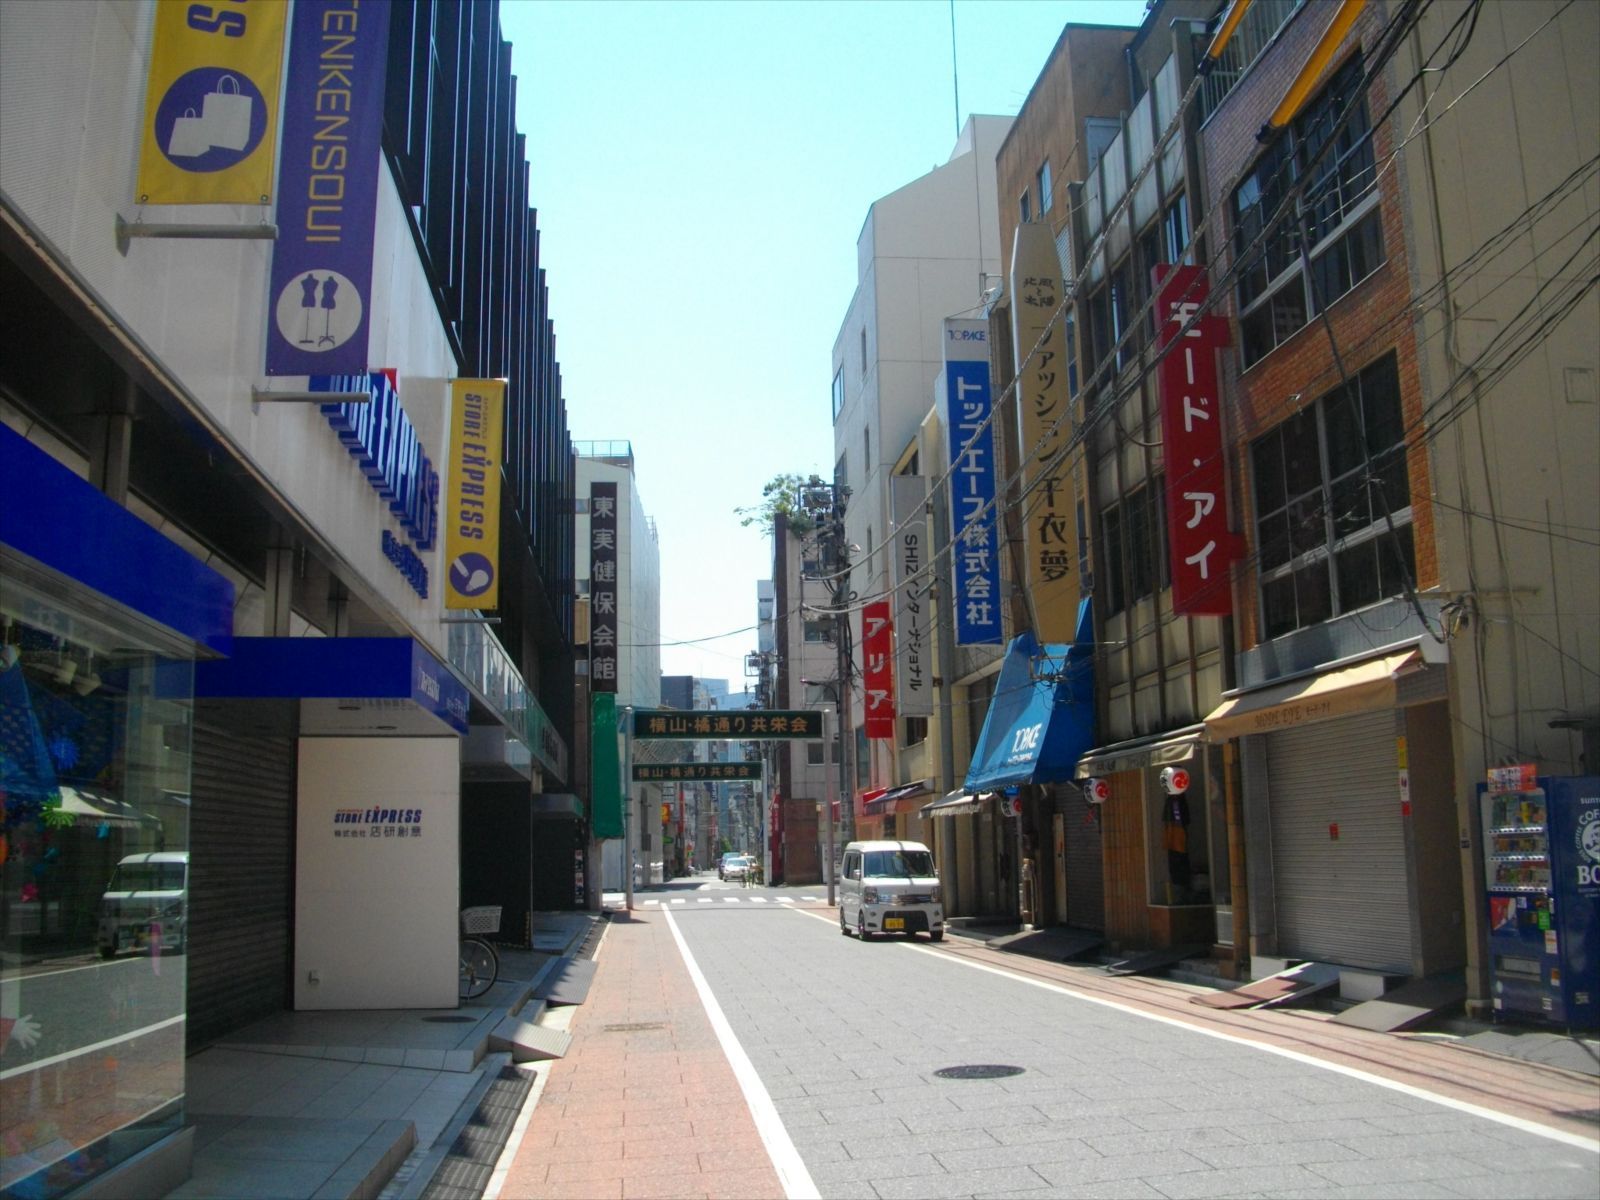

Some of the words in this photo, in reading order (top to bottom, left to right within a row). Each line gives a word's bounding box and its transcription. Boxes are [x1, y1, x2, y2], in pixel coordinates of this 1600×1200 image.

[948, 329, 986, 341] TOPACE
[463, 392, 481, 438] STORE
[1170, 301, 1216, 580] モード・アイ
[459, 442, 492, 541] EXPRESS
[592, 497, 616, 679] 東実健保会館
[866, 617, 889, 710] アリア
[334, 813, 362, 824] STORE
[364, 806, 422, 824] EXPRESS
